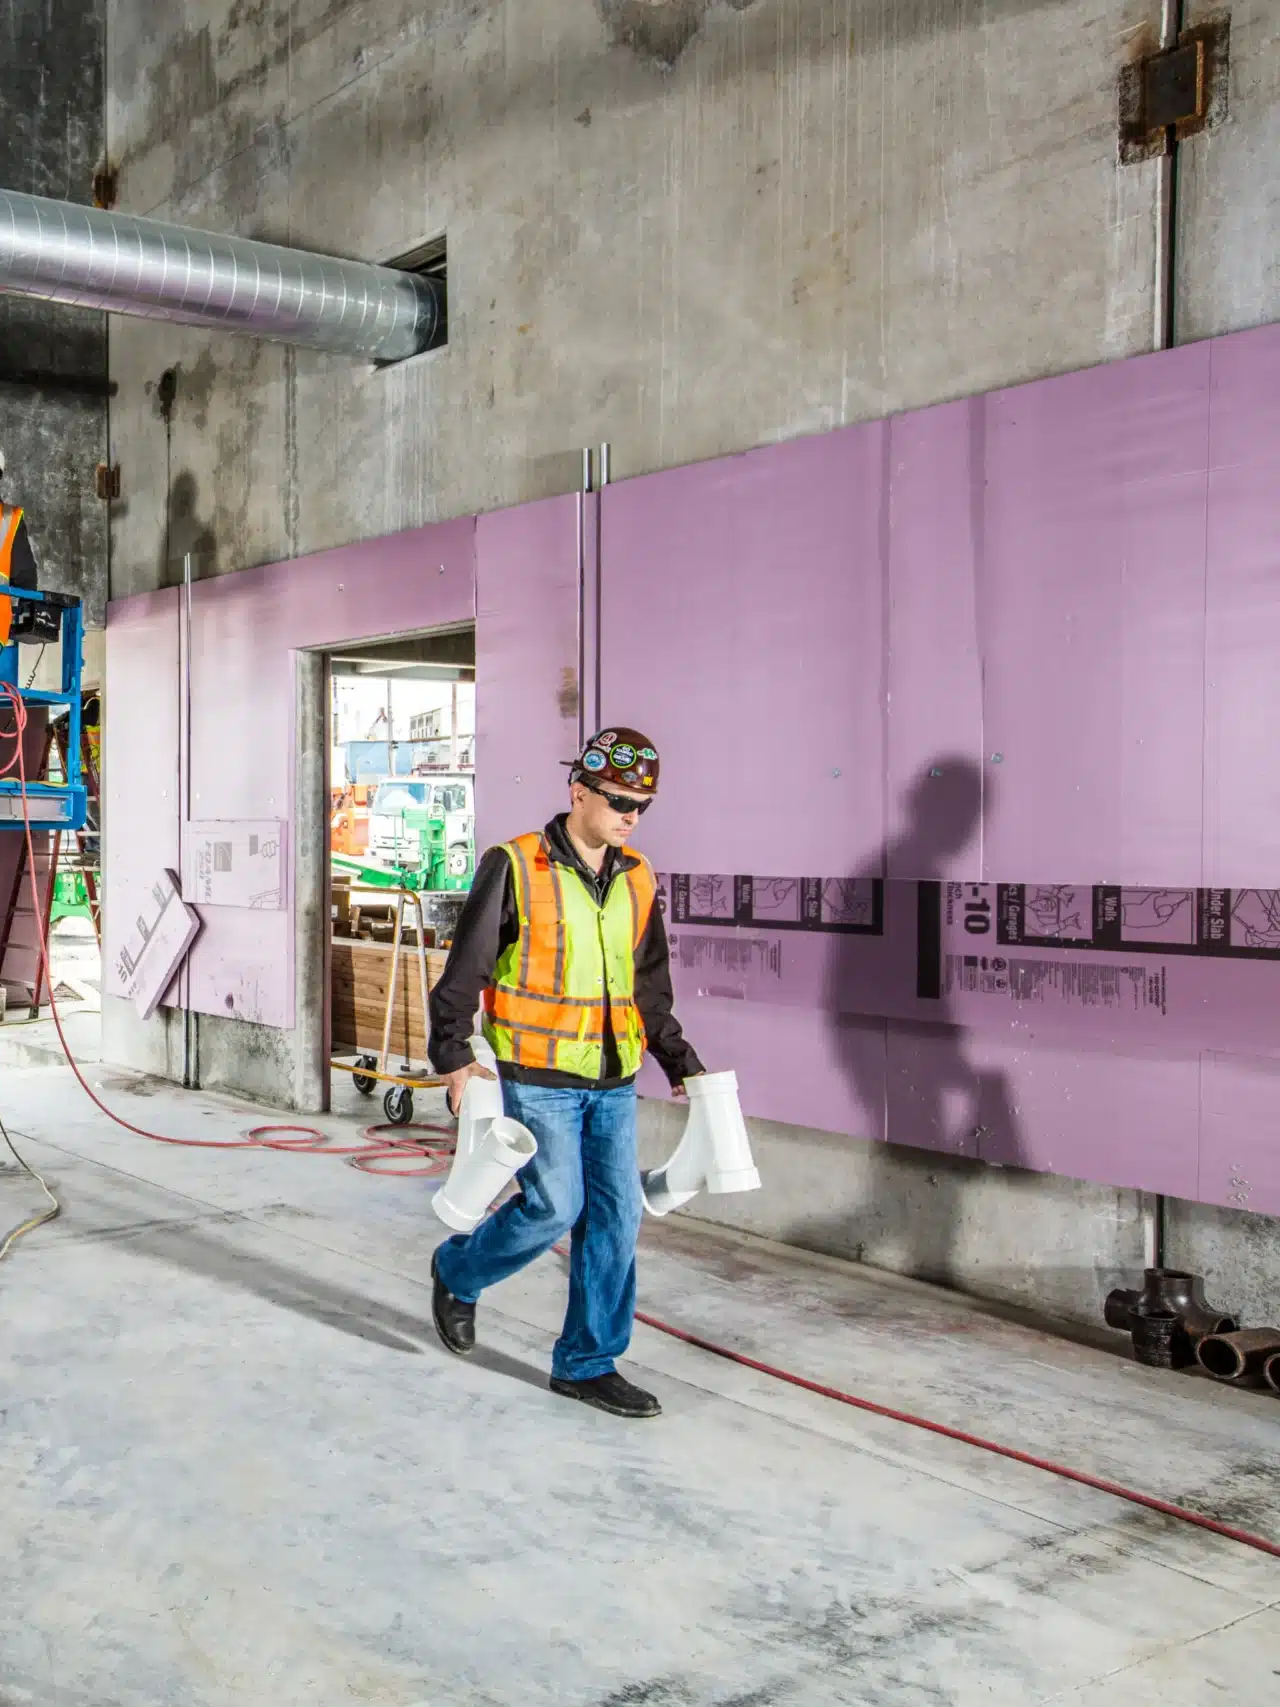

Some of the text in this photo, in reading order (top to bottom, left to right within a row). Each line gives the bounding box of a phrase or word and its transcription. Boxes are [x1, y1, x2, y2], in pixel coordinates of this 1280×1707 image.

[742, 883, 751, 904] Walls
[676, 890, 687, 920] Garages
[808, 900, 818, 918] Slab
[1104, 897, 1118, 921] Walls
[1006, 905, 1020, 941] Garages
[1211, 918, 1225, 939] Slab
